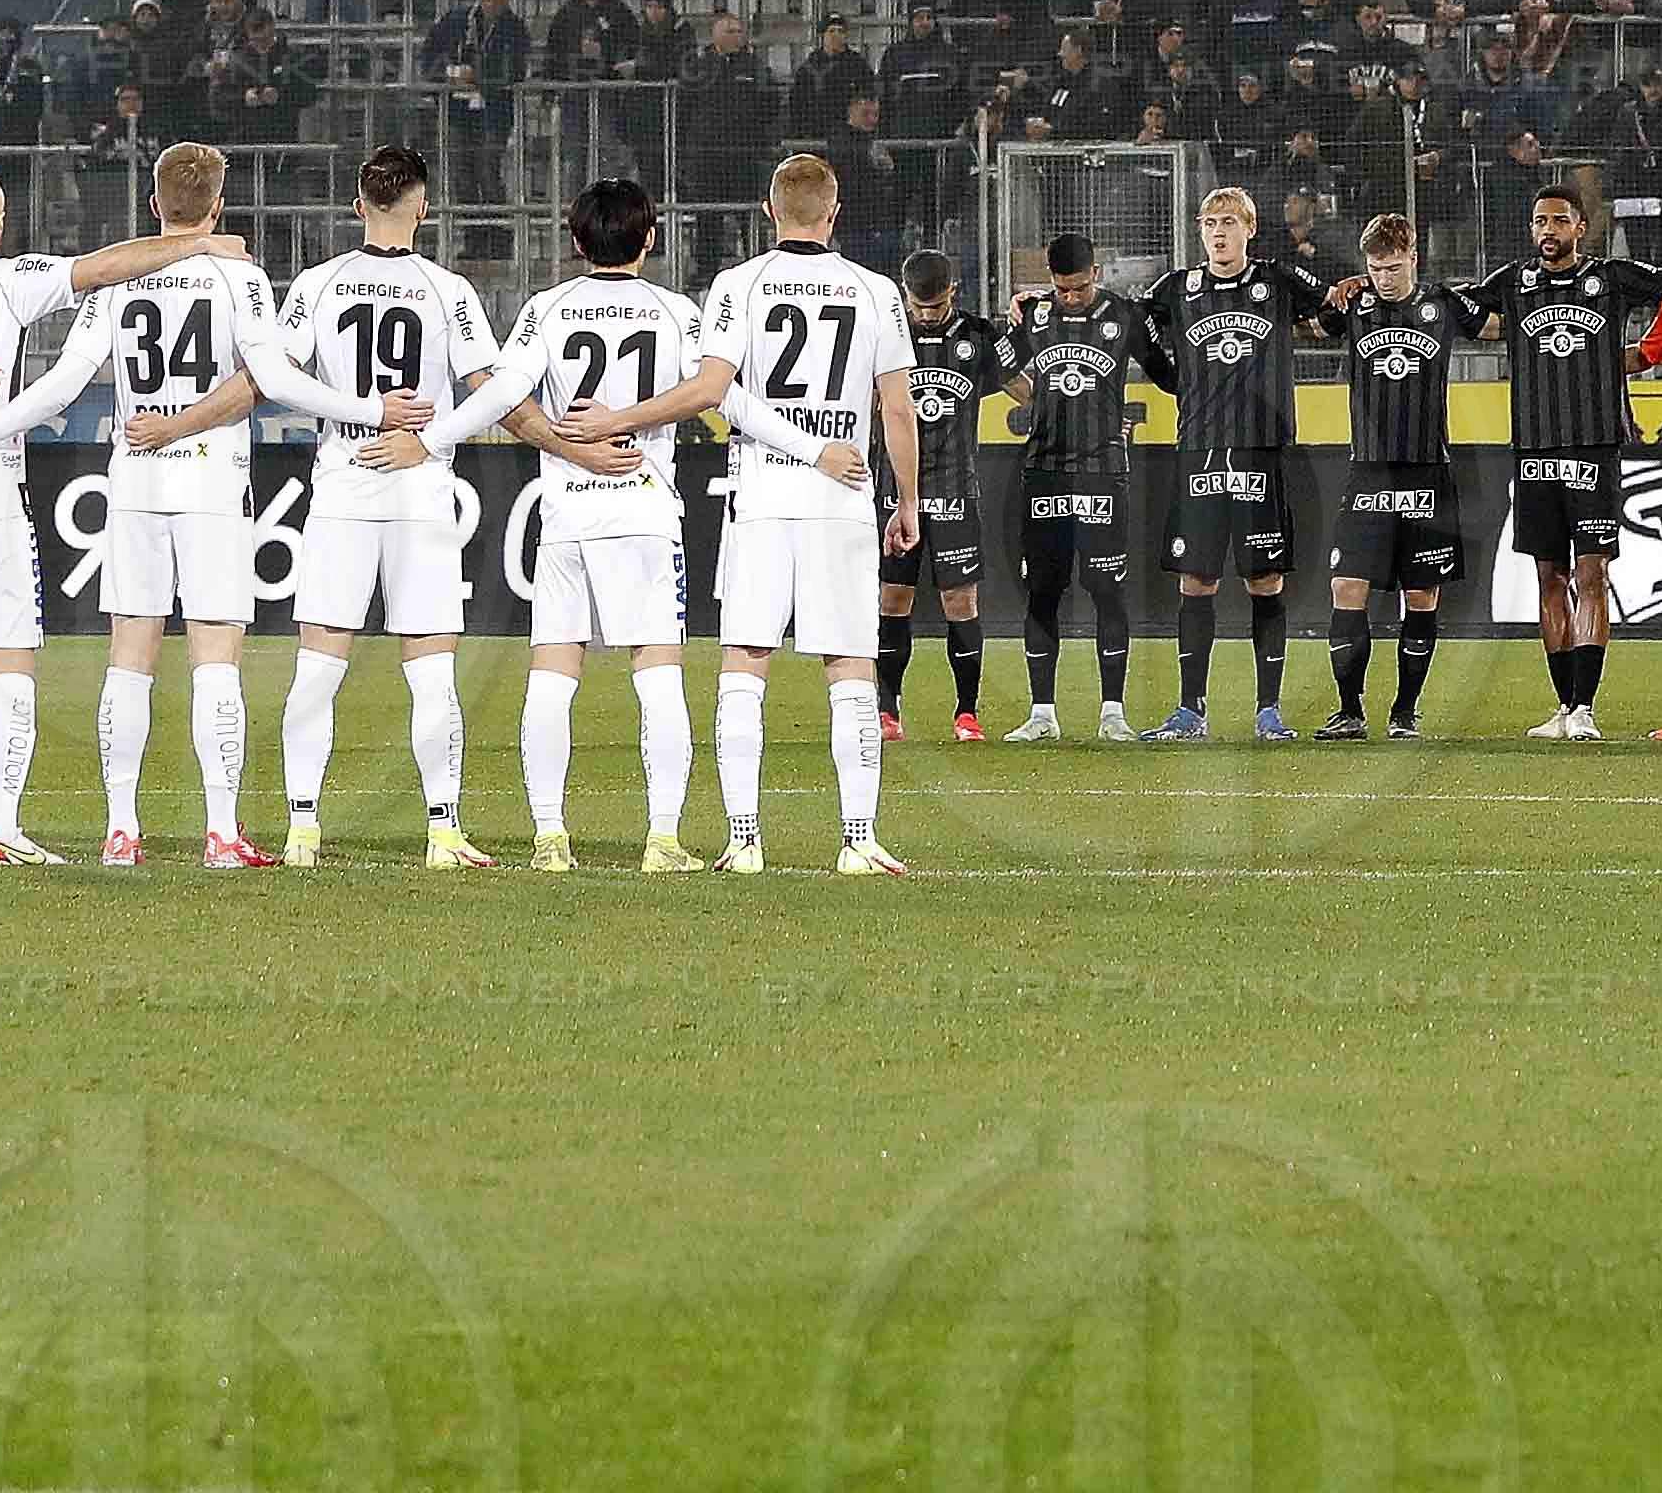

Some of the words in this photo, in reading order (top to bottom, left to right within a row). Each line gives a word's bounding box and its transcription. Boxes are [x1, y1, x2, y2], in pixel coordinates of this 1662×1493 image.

[14, 257, 55, 274] Zipfer
[1189, 315, 1268, 340] PUNTIGAMER
[1525, 308, 1602, 333] PUNTIGAMER
[120, 299, 218, 396] 34
[337, 302, 423, 399] 19
[764, 303, 857, 401] 27
[1359, 331, 1436, 354] PUNTIGAMER
[562, 329, 657, 413] 21
[1038, 347, 1112, 373] PUNTIGAMER
[909, 369, 970, 399] NTIGAMER
[1190, 472, 1266, 496] GRAZ
[1521, 460, 1598, 483] GRAZ
[1032, 496, 1112, 518] GRAZ
[1353, 490, 1434, 512] GRAZ
[12, 697, 32, 734] LUCE
[215, 699, 237, 737] LUCE
[860, 729, 880, 770] MOLTO
[4, 737, 25, 796] MOLTO
[221, 739, 238, 794] MOLTO
